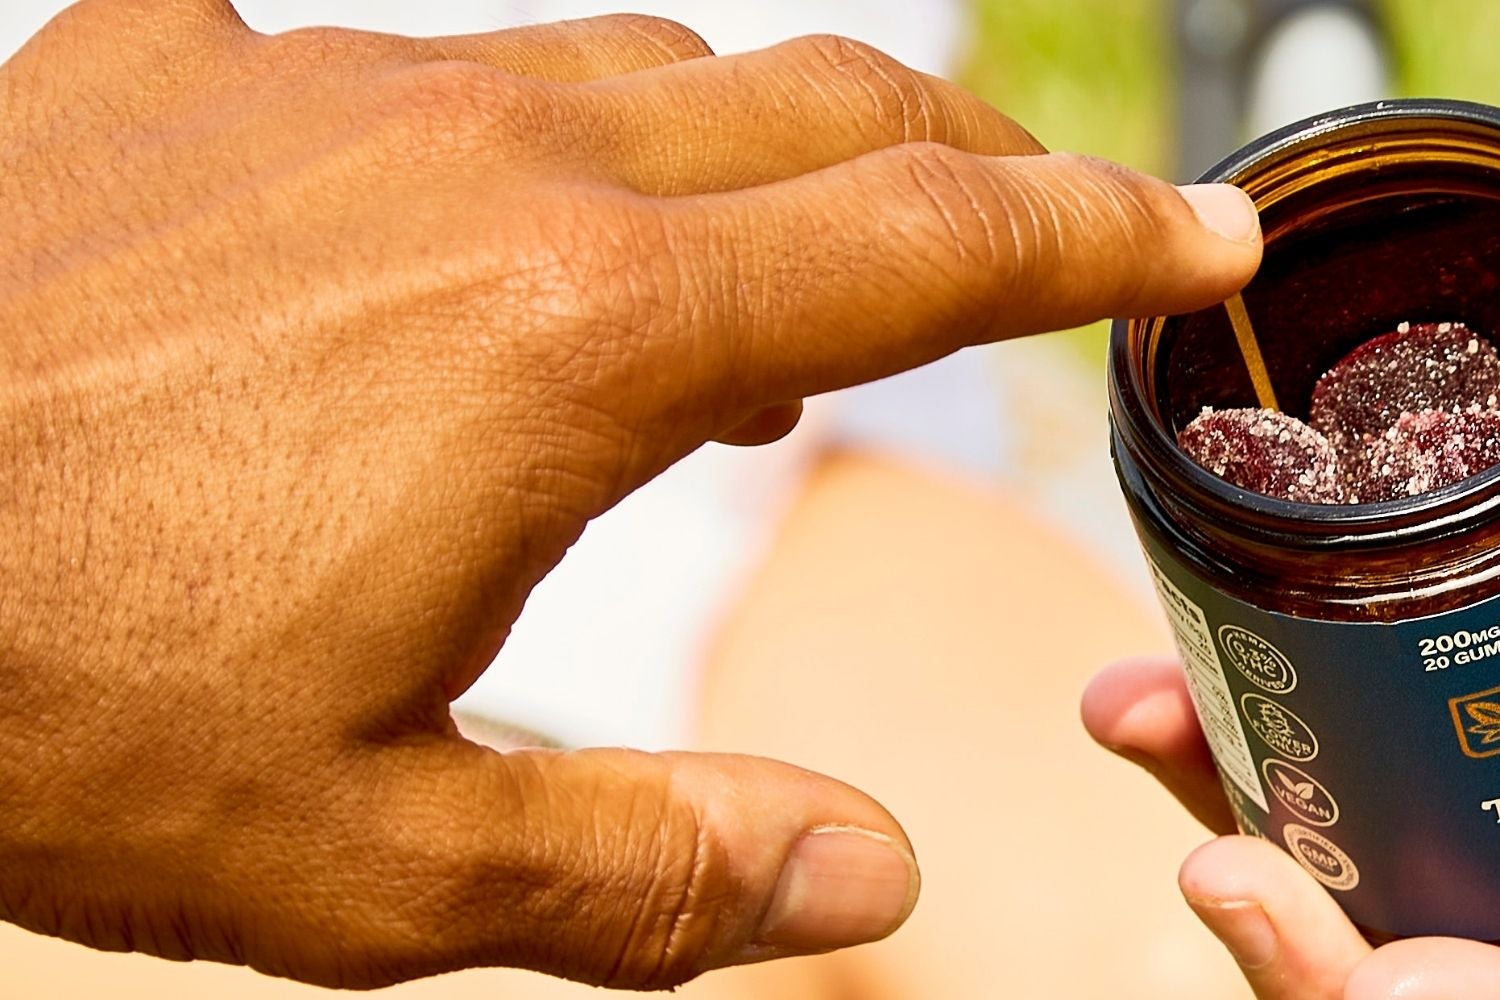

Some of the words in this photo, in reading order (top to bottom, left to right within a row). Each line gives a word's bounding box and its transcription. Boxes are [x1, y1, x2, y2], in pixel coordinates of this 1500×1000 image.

[1239, 652, 1277, 678] THC
[1422, 657, 1451, 672] 20
[1275, 785, 1331, 820] VEGAN
[1300, 843, 1338, 868] GMP
